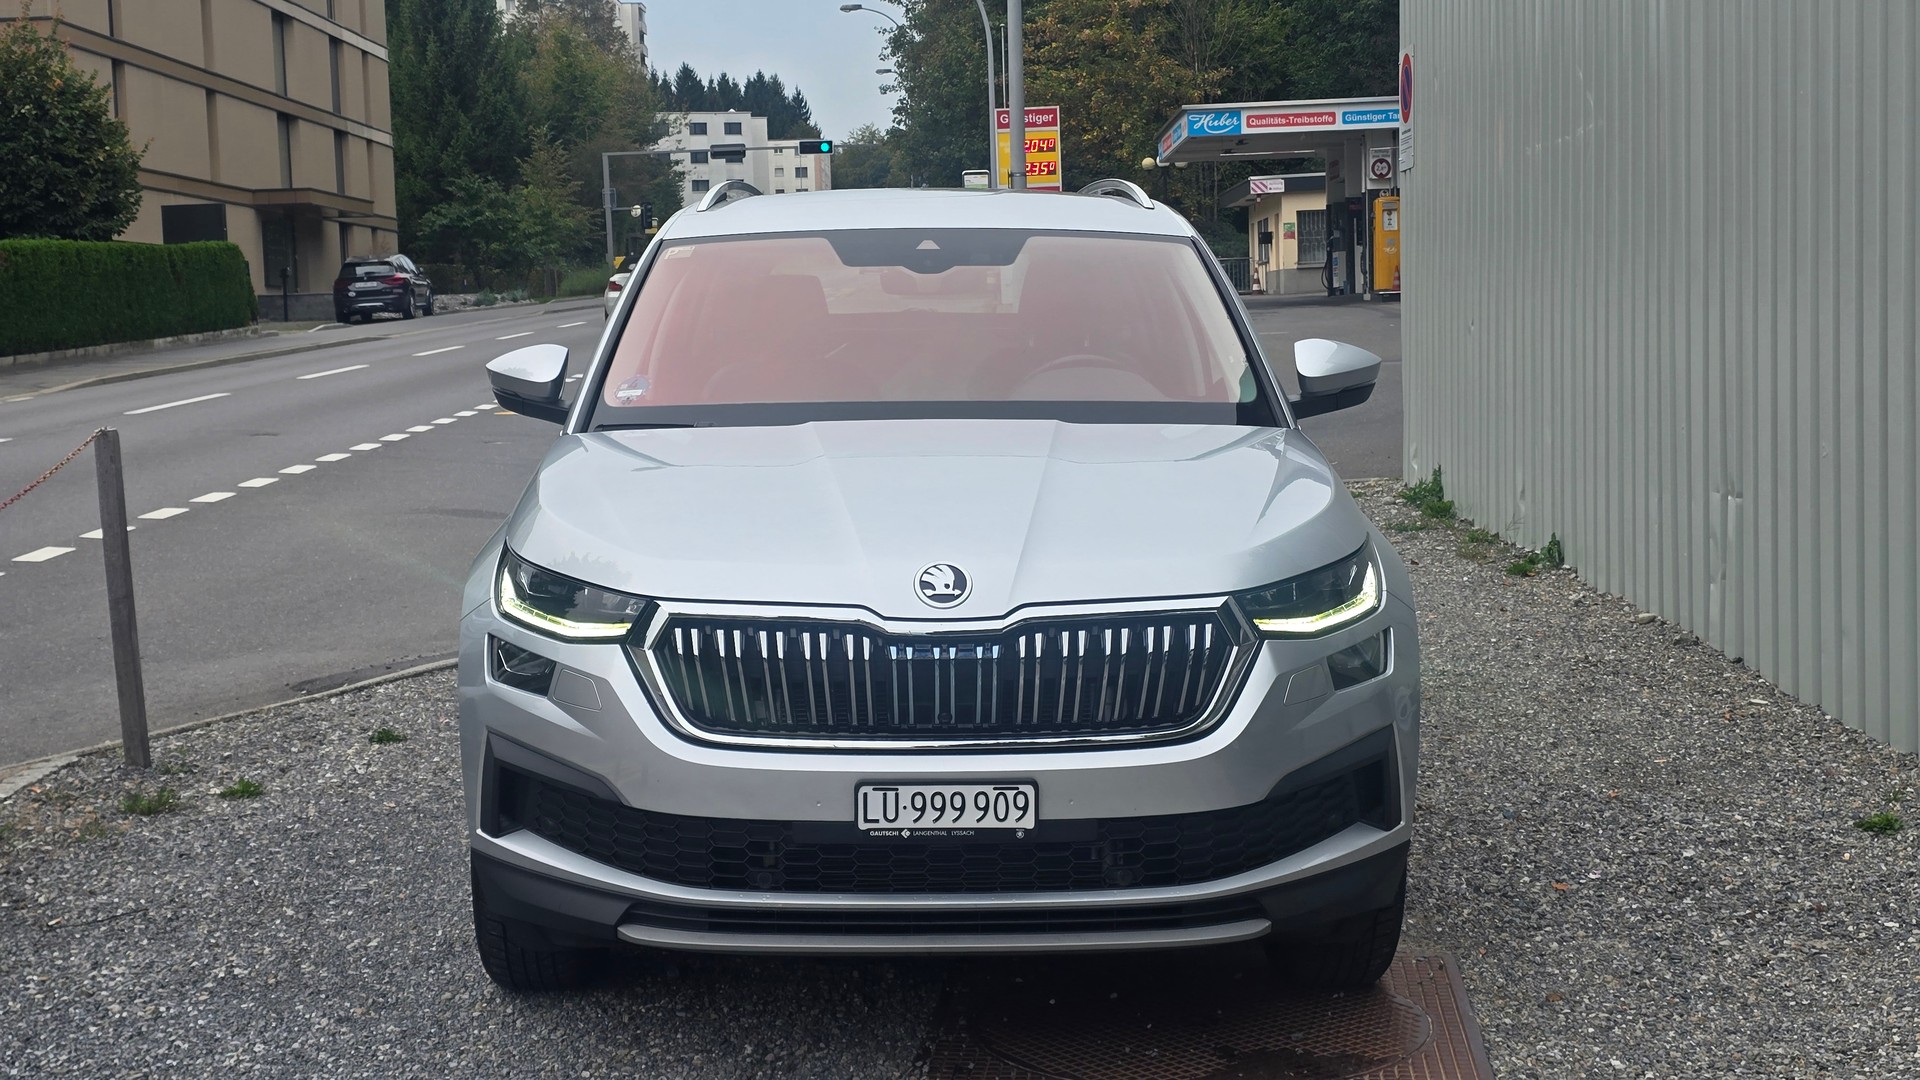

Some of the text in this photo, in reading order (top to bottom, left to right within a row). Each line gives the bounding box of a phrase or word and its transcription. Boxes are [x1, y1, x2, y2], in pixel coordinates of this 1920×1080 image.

[1000, 113, 1054, 124] Gstiger
[1249, 114, 1334, 126] Qualitäts-Treibstoffe
[1345, 112, 1386, 122] Günstiger
[1188, 112, 1240, 134] Huber
